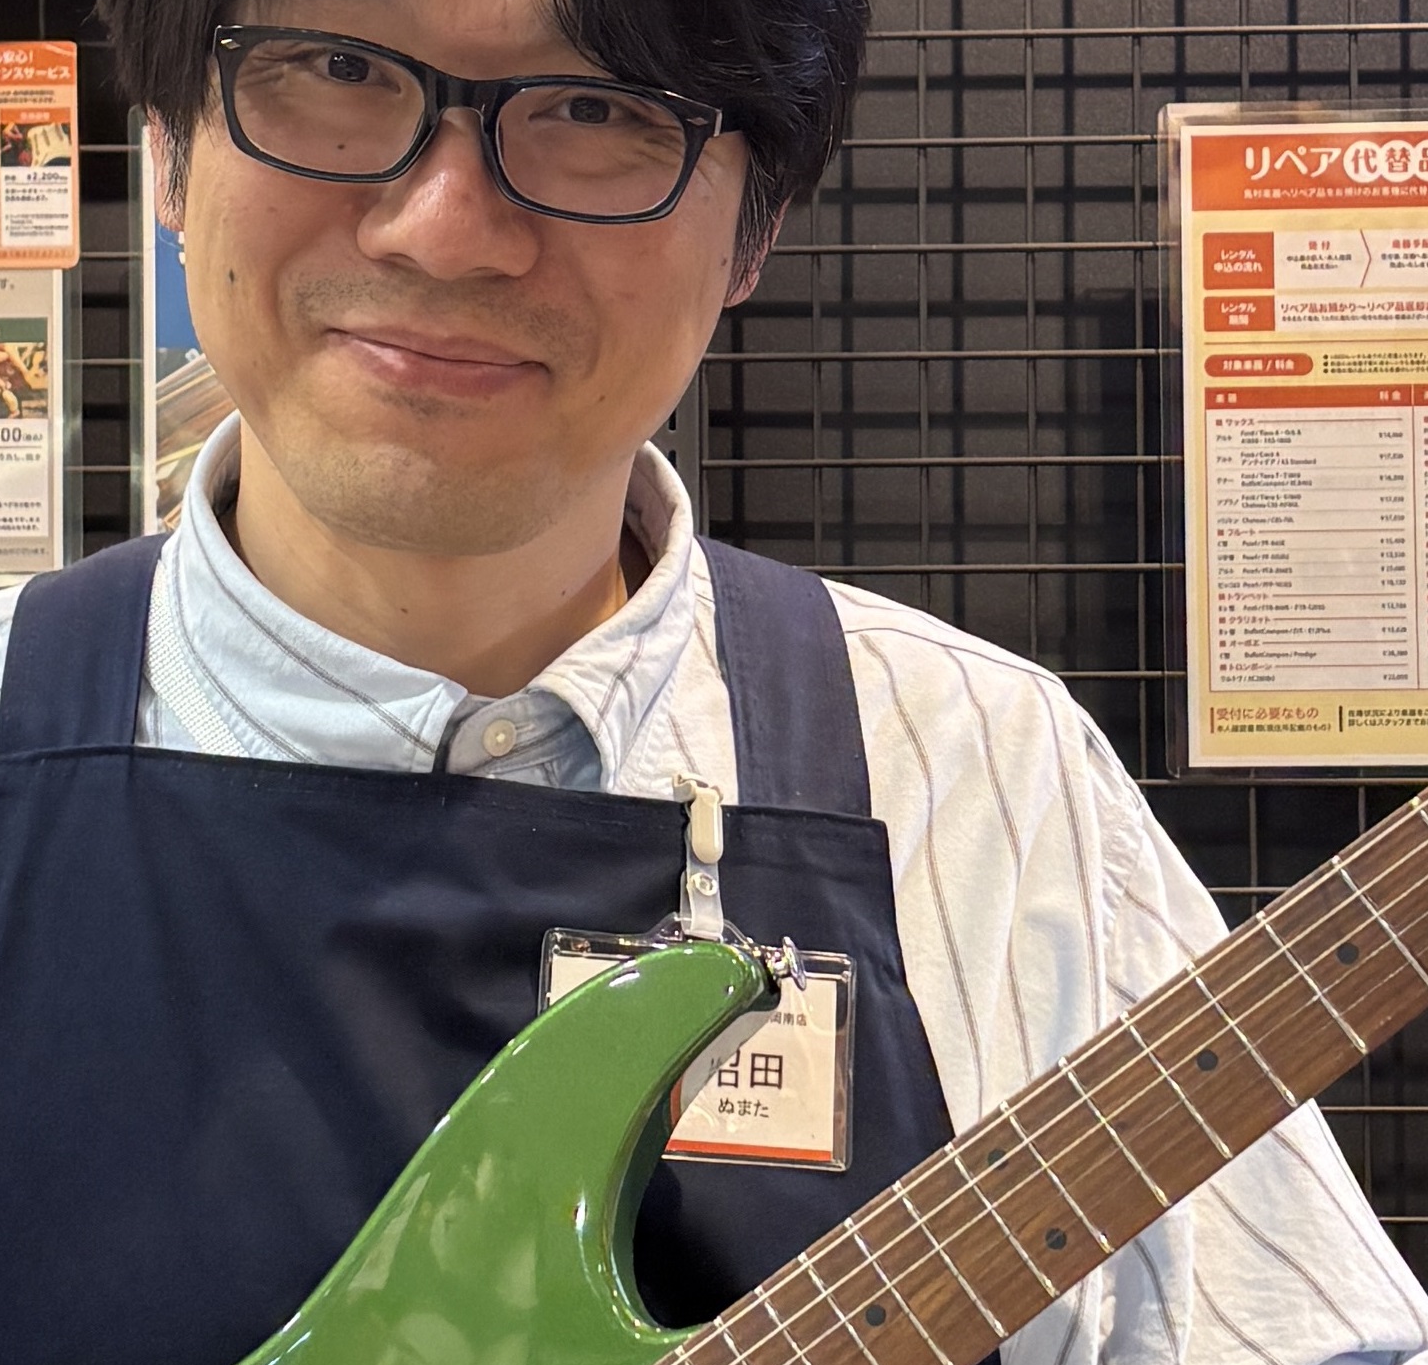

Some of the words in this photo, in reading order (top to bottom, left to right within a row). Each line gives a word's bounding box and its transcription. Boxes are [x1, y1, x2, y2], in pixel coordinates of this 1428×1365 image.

[1220, 249, 1256, 260] レンタル
[1220, 302, 1257, 313] レンタル
[1215, 706, 1320, 722] 受付に必要なもの
[718, 1098, 770, 1118] ぬまた
